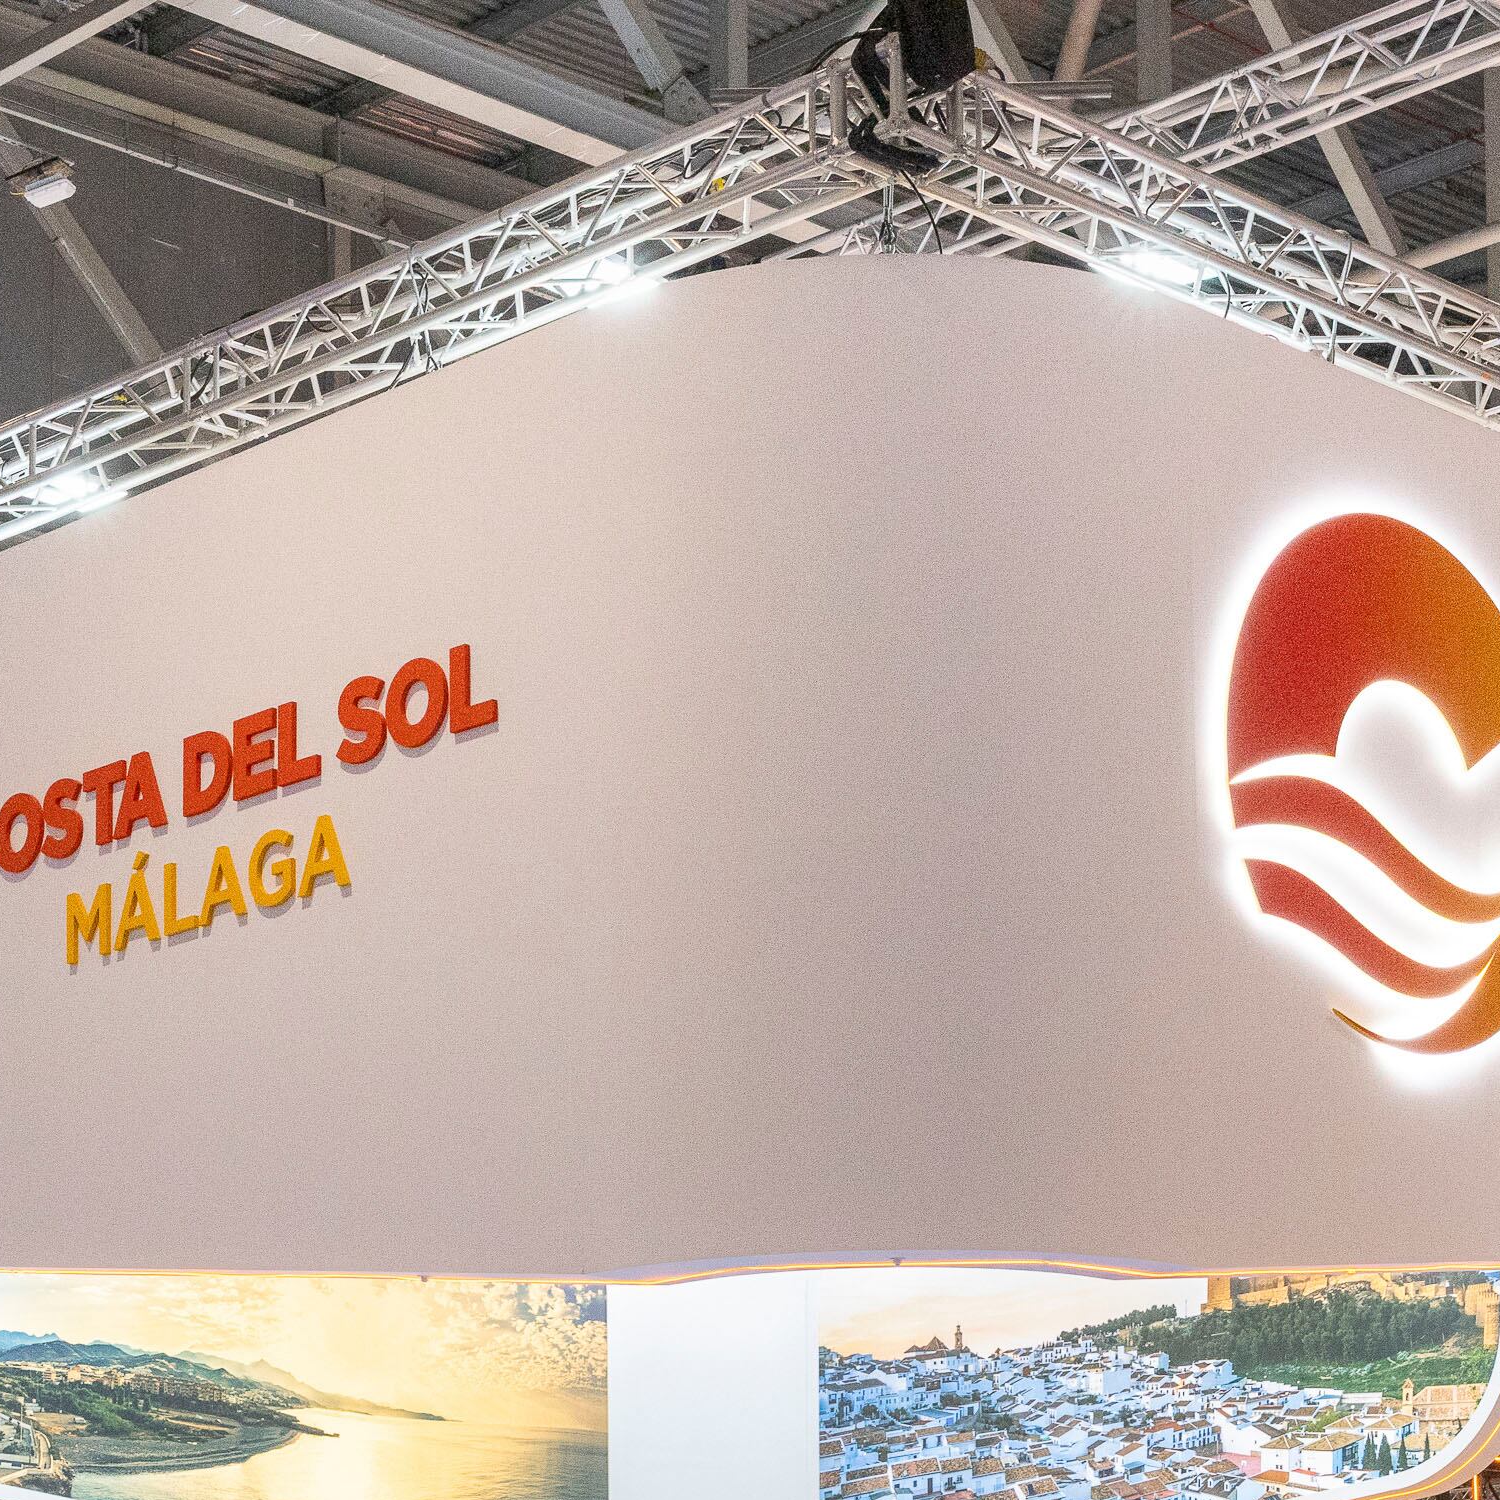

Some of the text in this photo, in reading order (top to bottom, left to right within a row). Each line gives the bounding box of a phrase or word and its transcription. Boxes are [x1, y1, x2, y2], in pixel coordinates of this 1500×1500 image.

[181, 701, 322, 820] DEL
[336, 643, 500, 766] SOL
[65, 814, 353, 967] MÁLAGA
